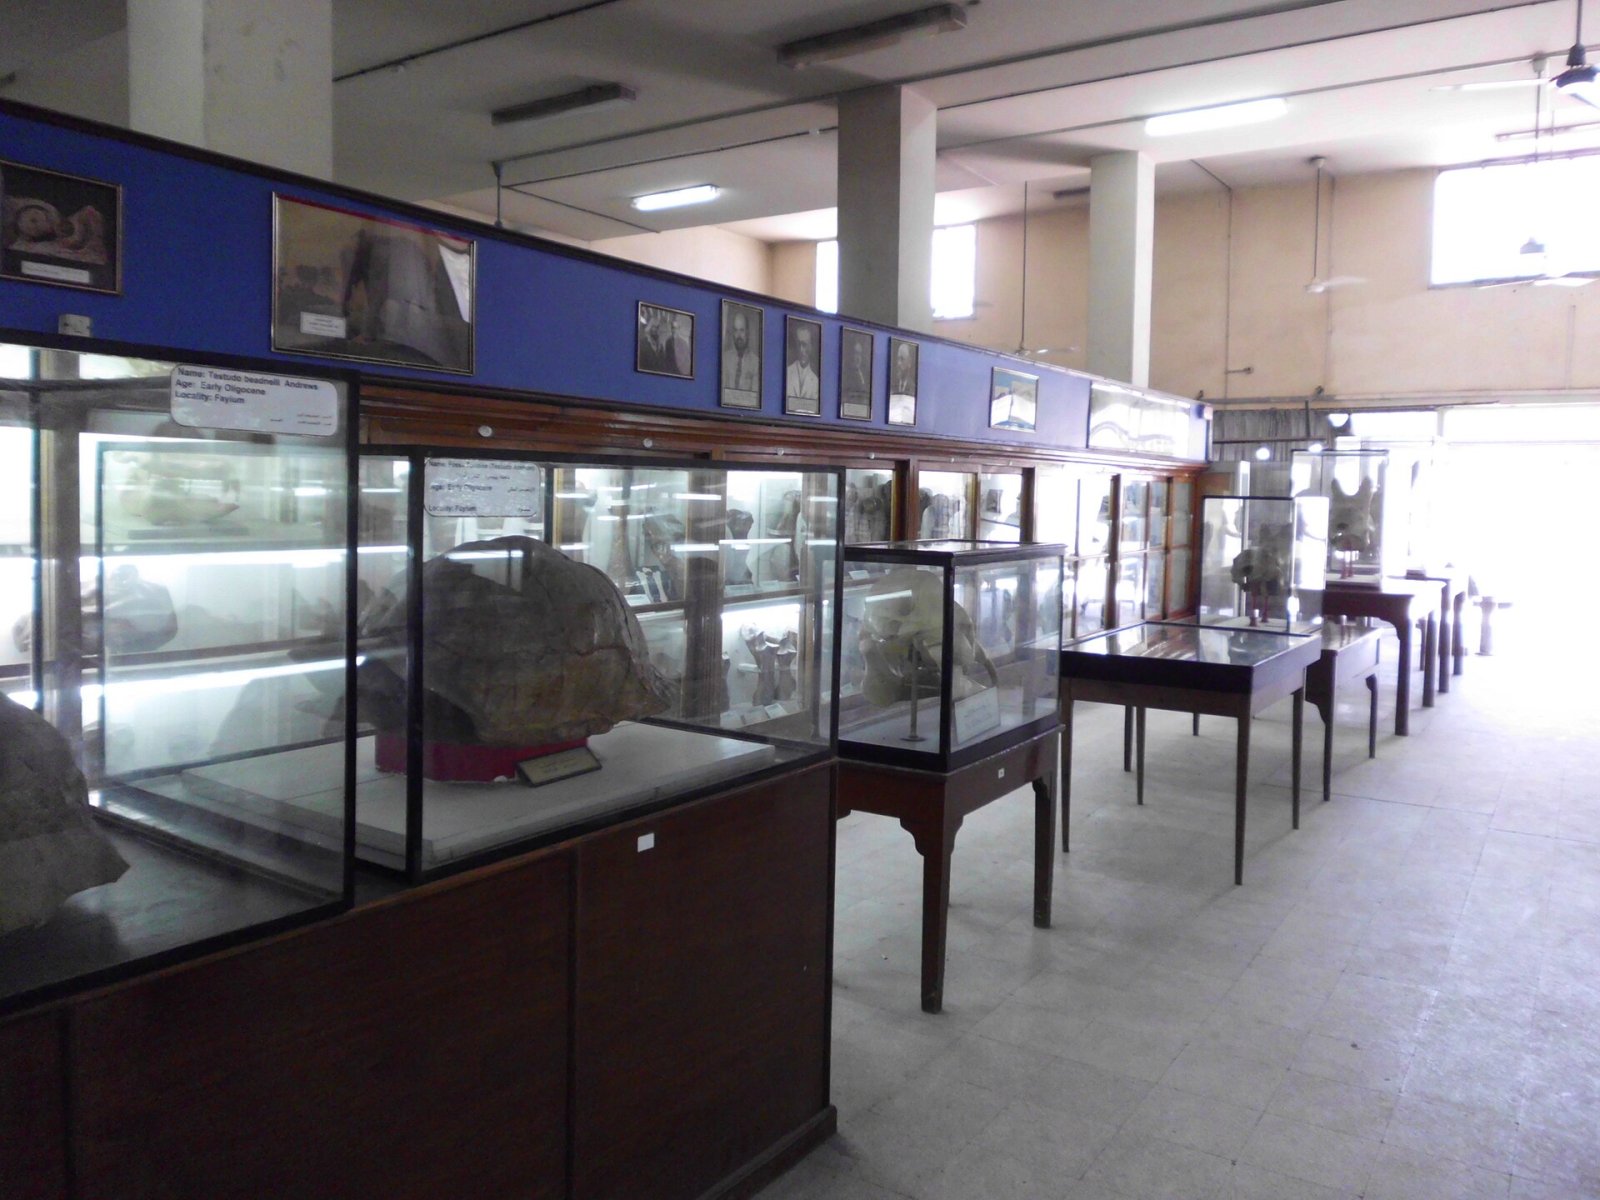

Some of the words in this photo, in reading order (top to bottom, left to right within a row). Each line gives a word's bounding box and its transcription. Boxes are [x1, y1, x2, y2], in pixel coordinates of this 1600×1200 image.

[175, 379, 195, 389] Age:
[200, 382, 222, 392] Early
[224, 384, 266, 395] Oligocene
[178, 367, 206, 378] Name:
[208, 370, 242, 382] Testudo
[284, 380, 318, 390] Andrews
